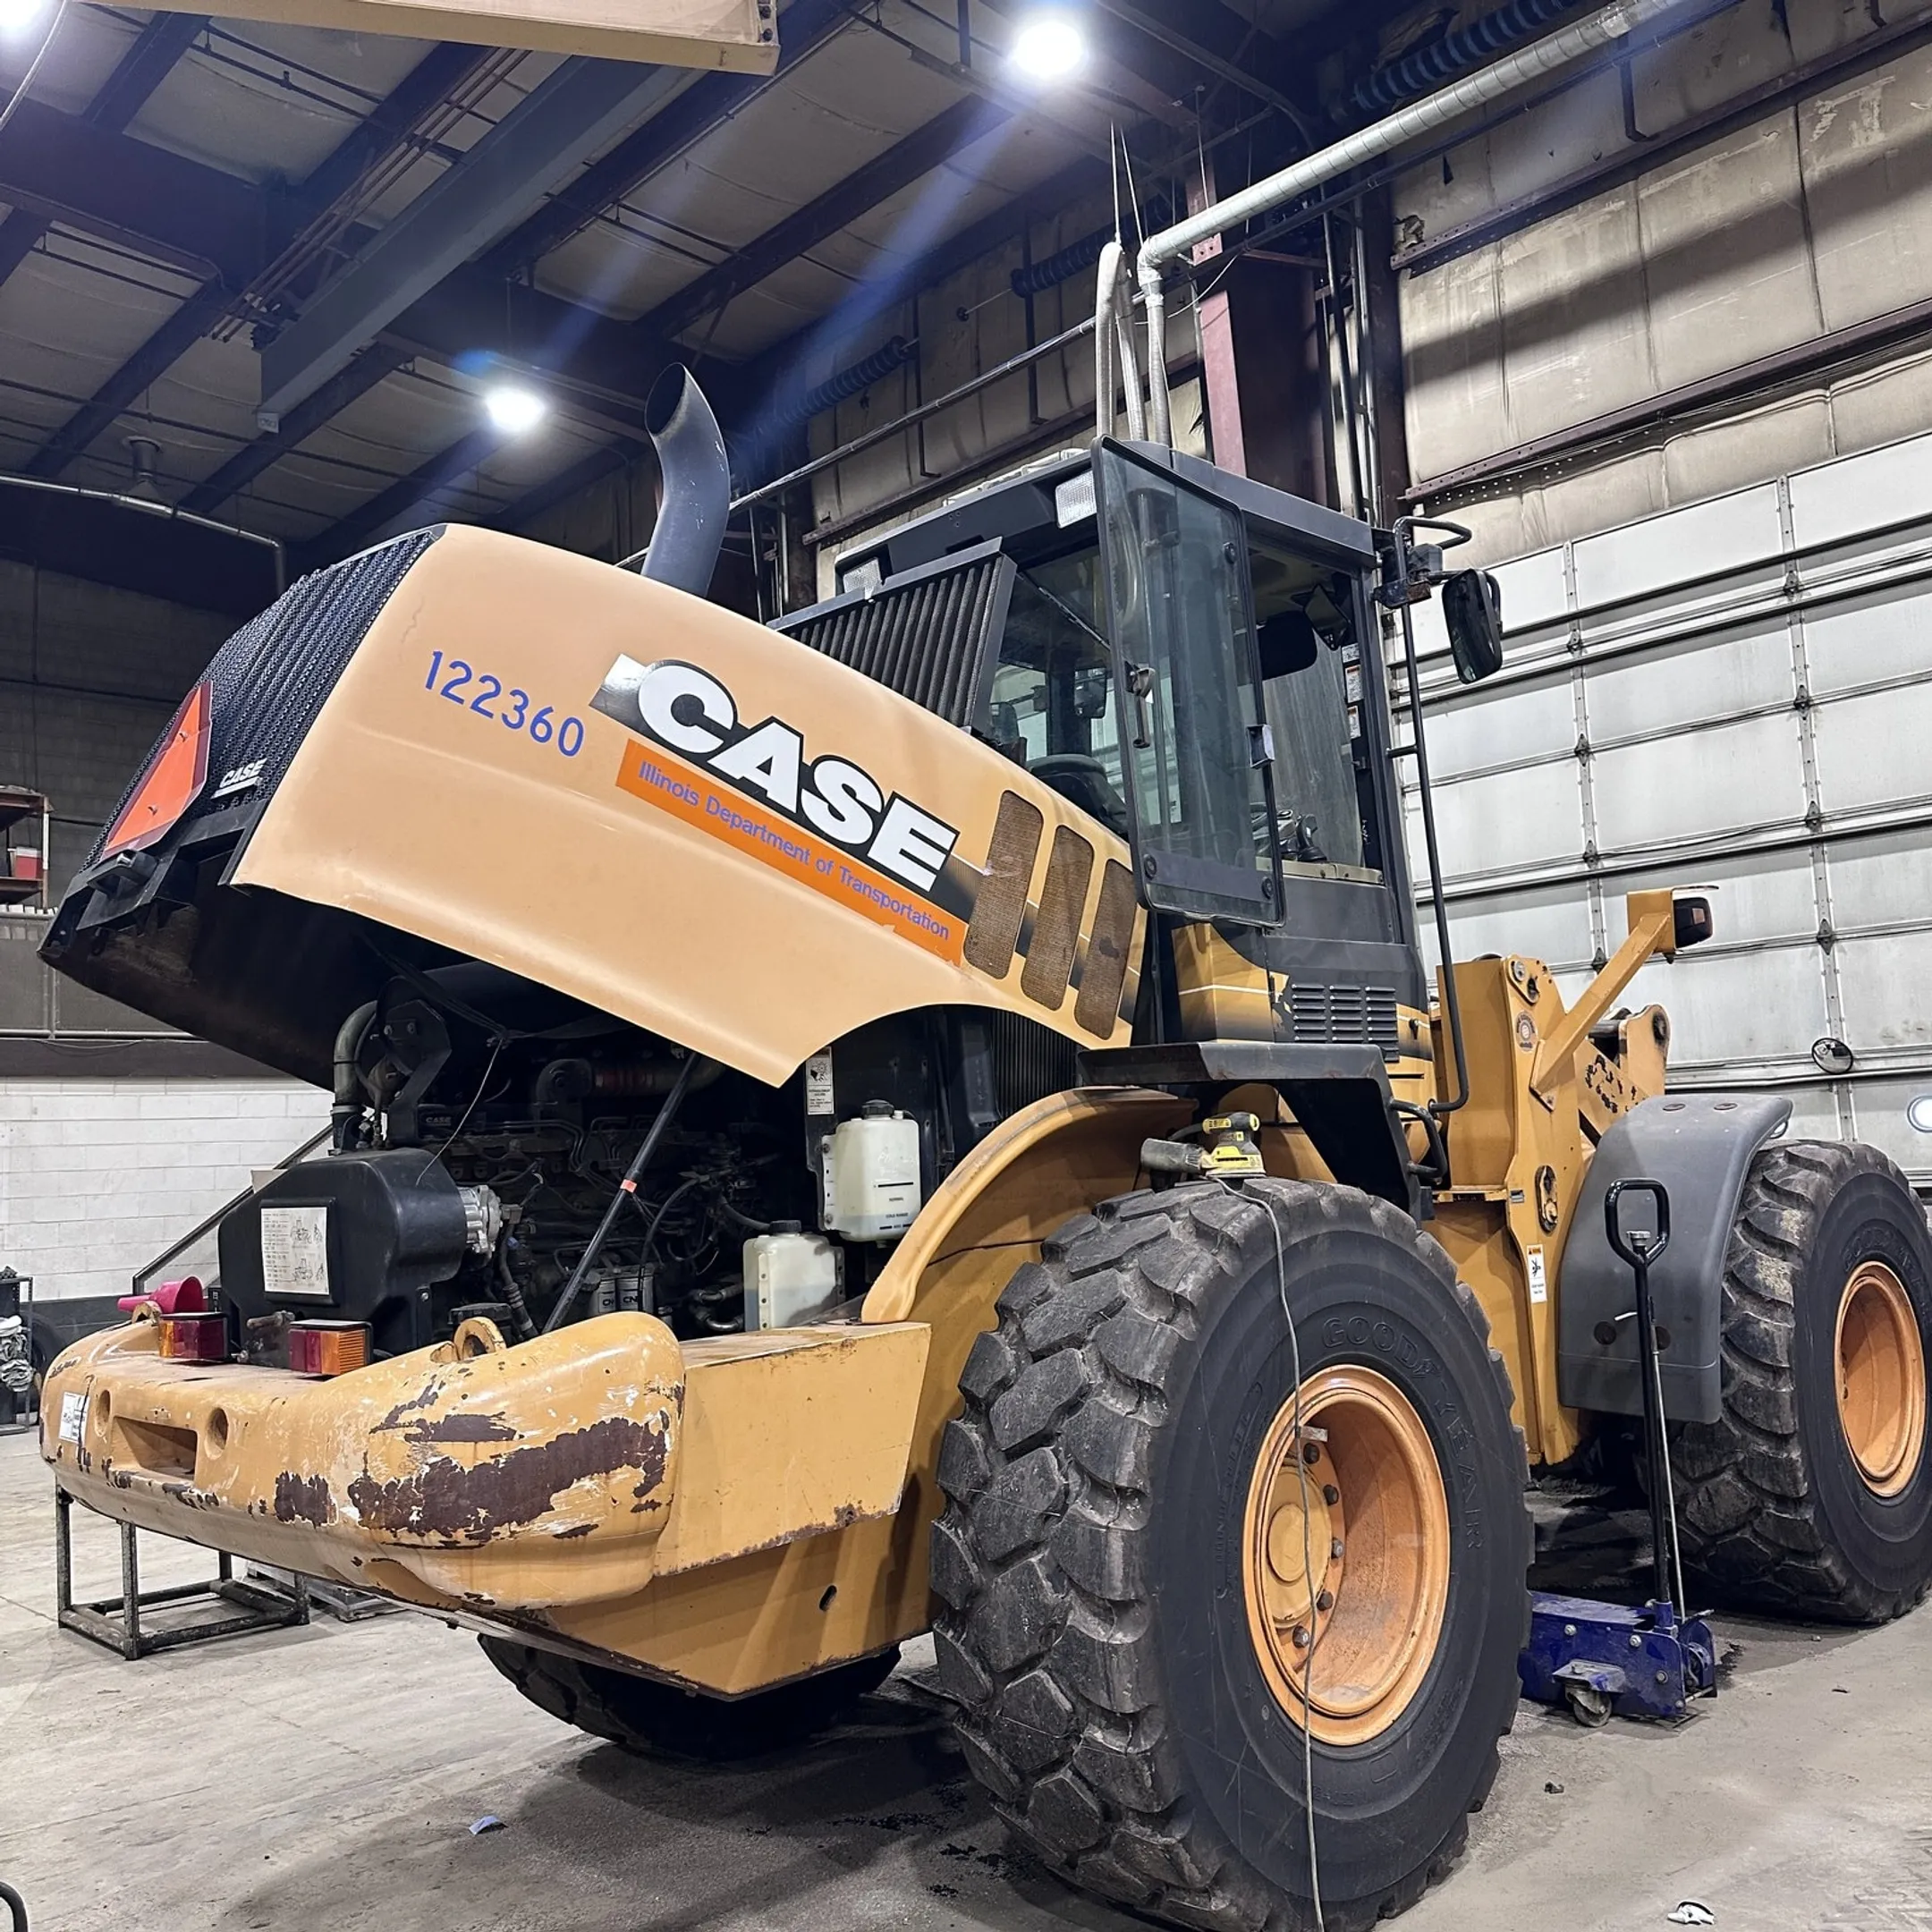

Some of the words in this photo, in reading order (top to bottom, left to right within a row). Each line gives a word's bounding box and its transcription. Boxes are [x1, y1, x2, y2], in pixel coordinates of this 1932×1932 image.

[219, 758, 267, 788] CASE
[426, 651, 584, 757] 122360
[638, 664, 958, 893] CASE
[639, 760, 700, 807] Illinois
[705, 796, 811, 866] Department
[816, 856, 835, 876] of
[839, 866, 950, 940] Transportation
